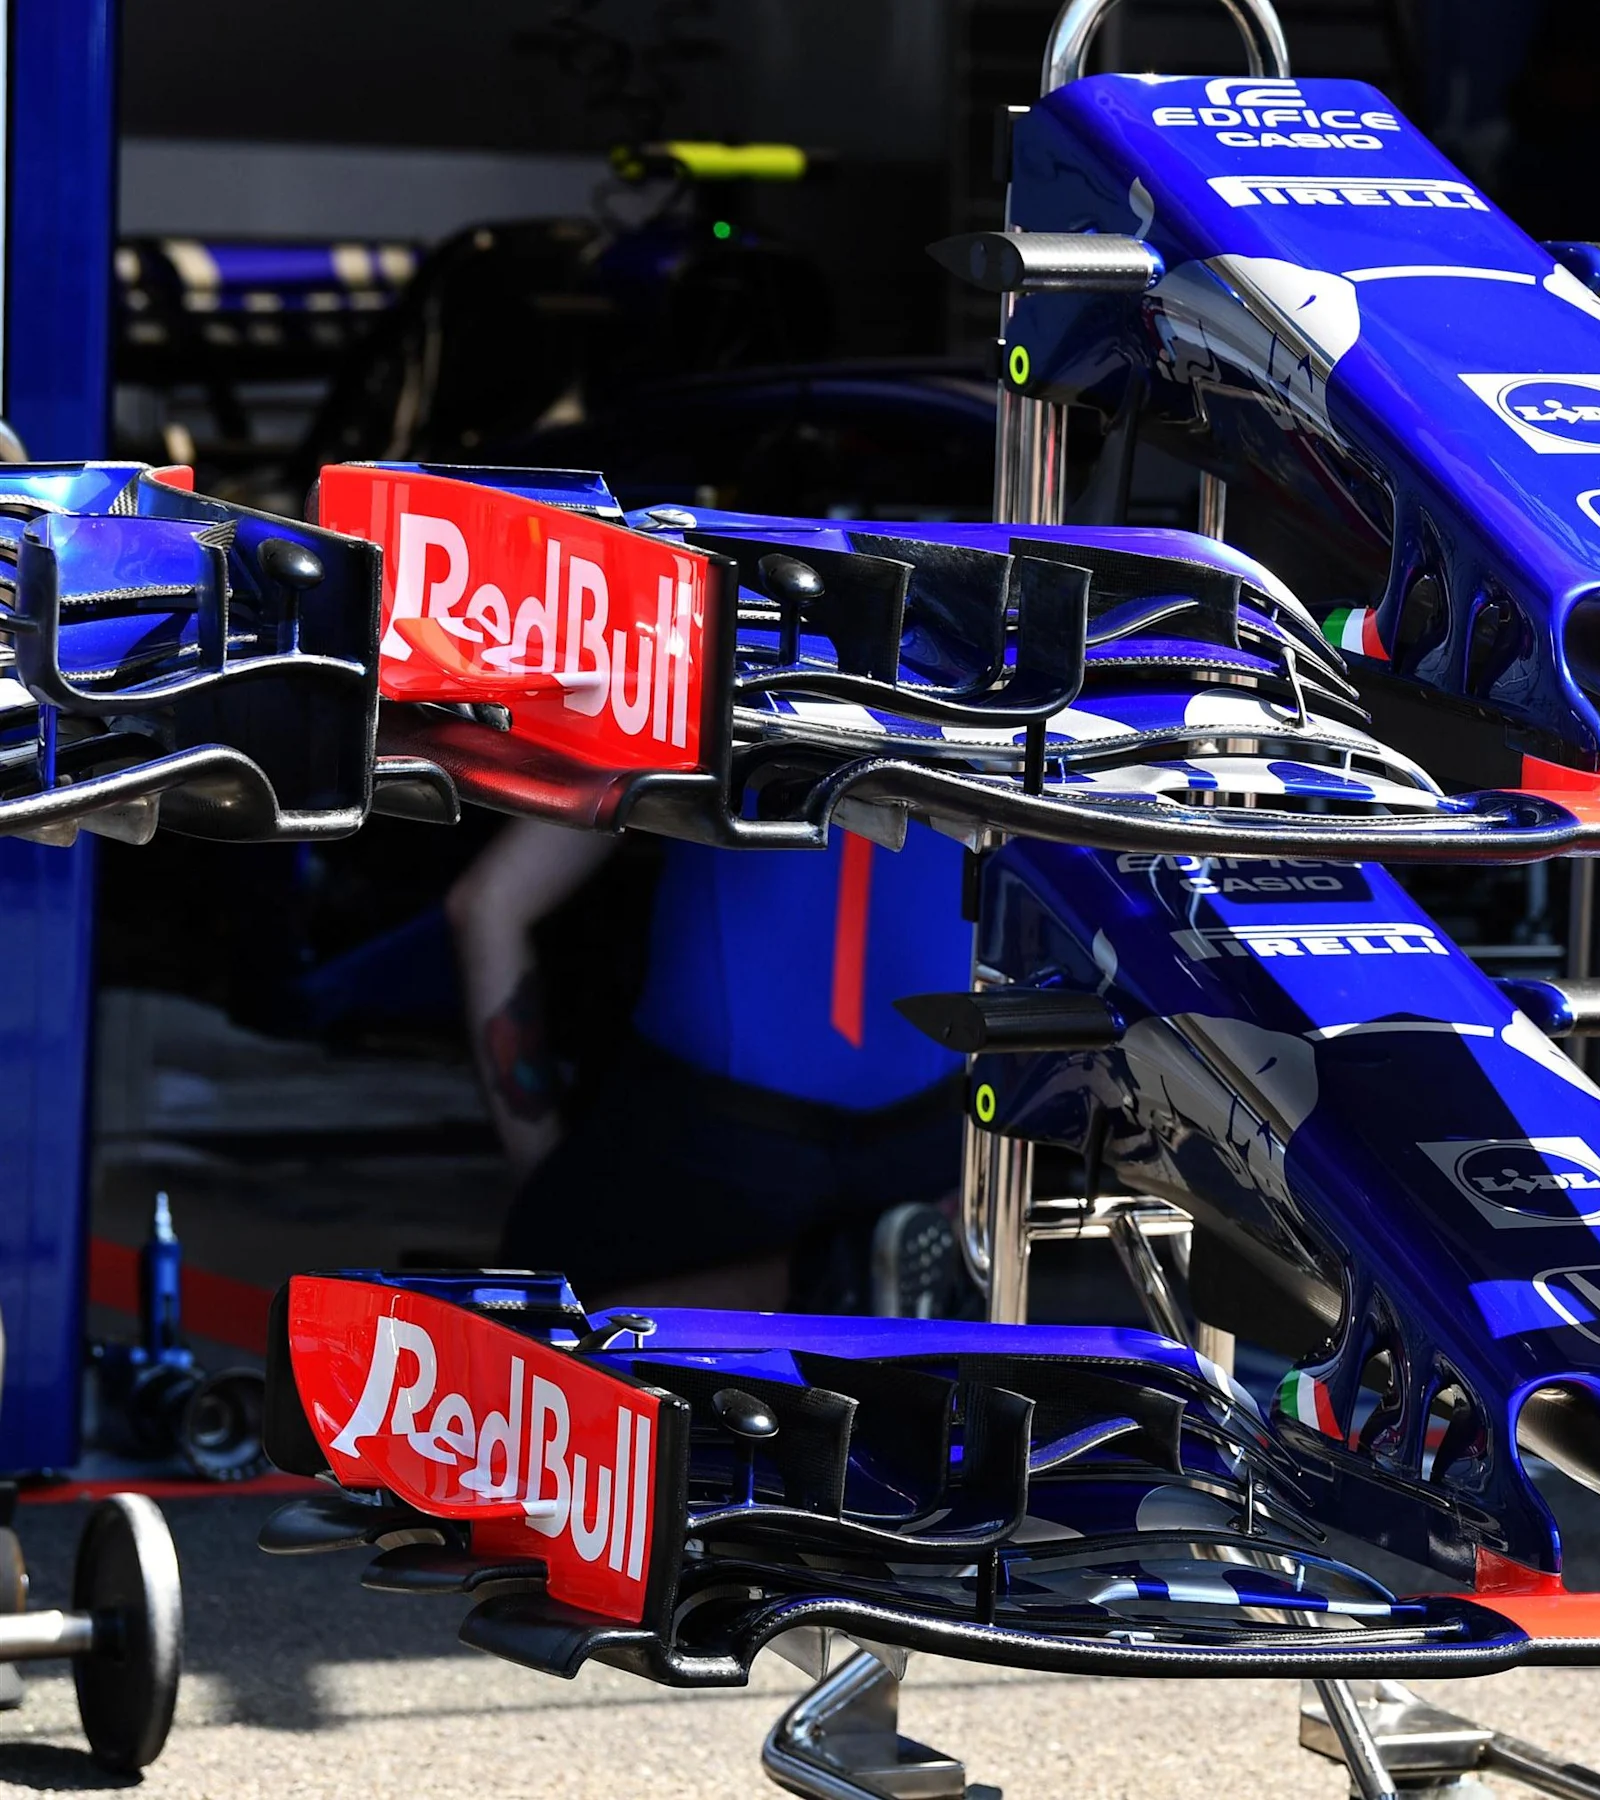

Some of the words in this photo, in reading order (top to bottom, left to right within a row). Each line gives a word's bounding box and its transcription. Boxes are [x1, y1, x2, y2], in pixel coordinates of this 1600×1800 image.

[1152, 107, 1401, 132] EDIFICE
[1216, 131, 1383, 150] CASIO
[1206, 175, 1491, 212] PIRELLI
[1180, 876, 1344, 894] CASIO
[1169, 922, 1450, 962] PIRELLI
